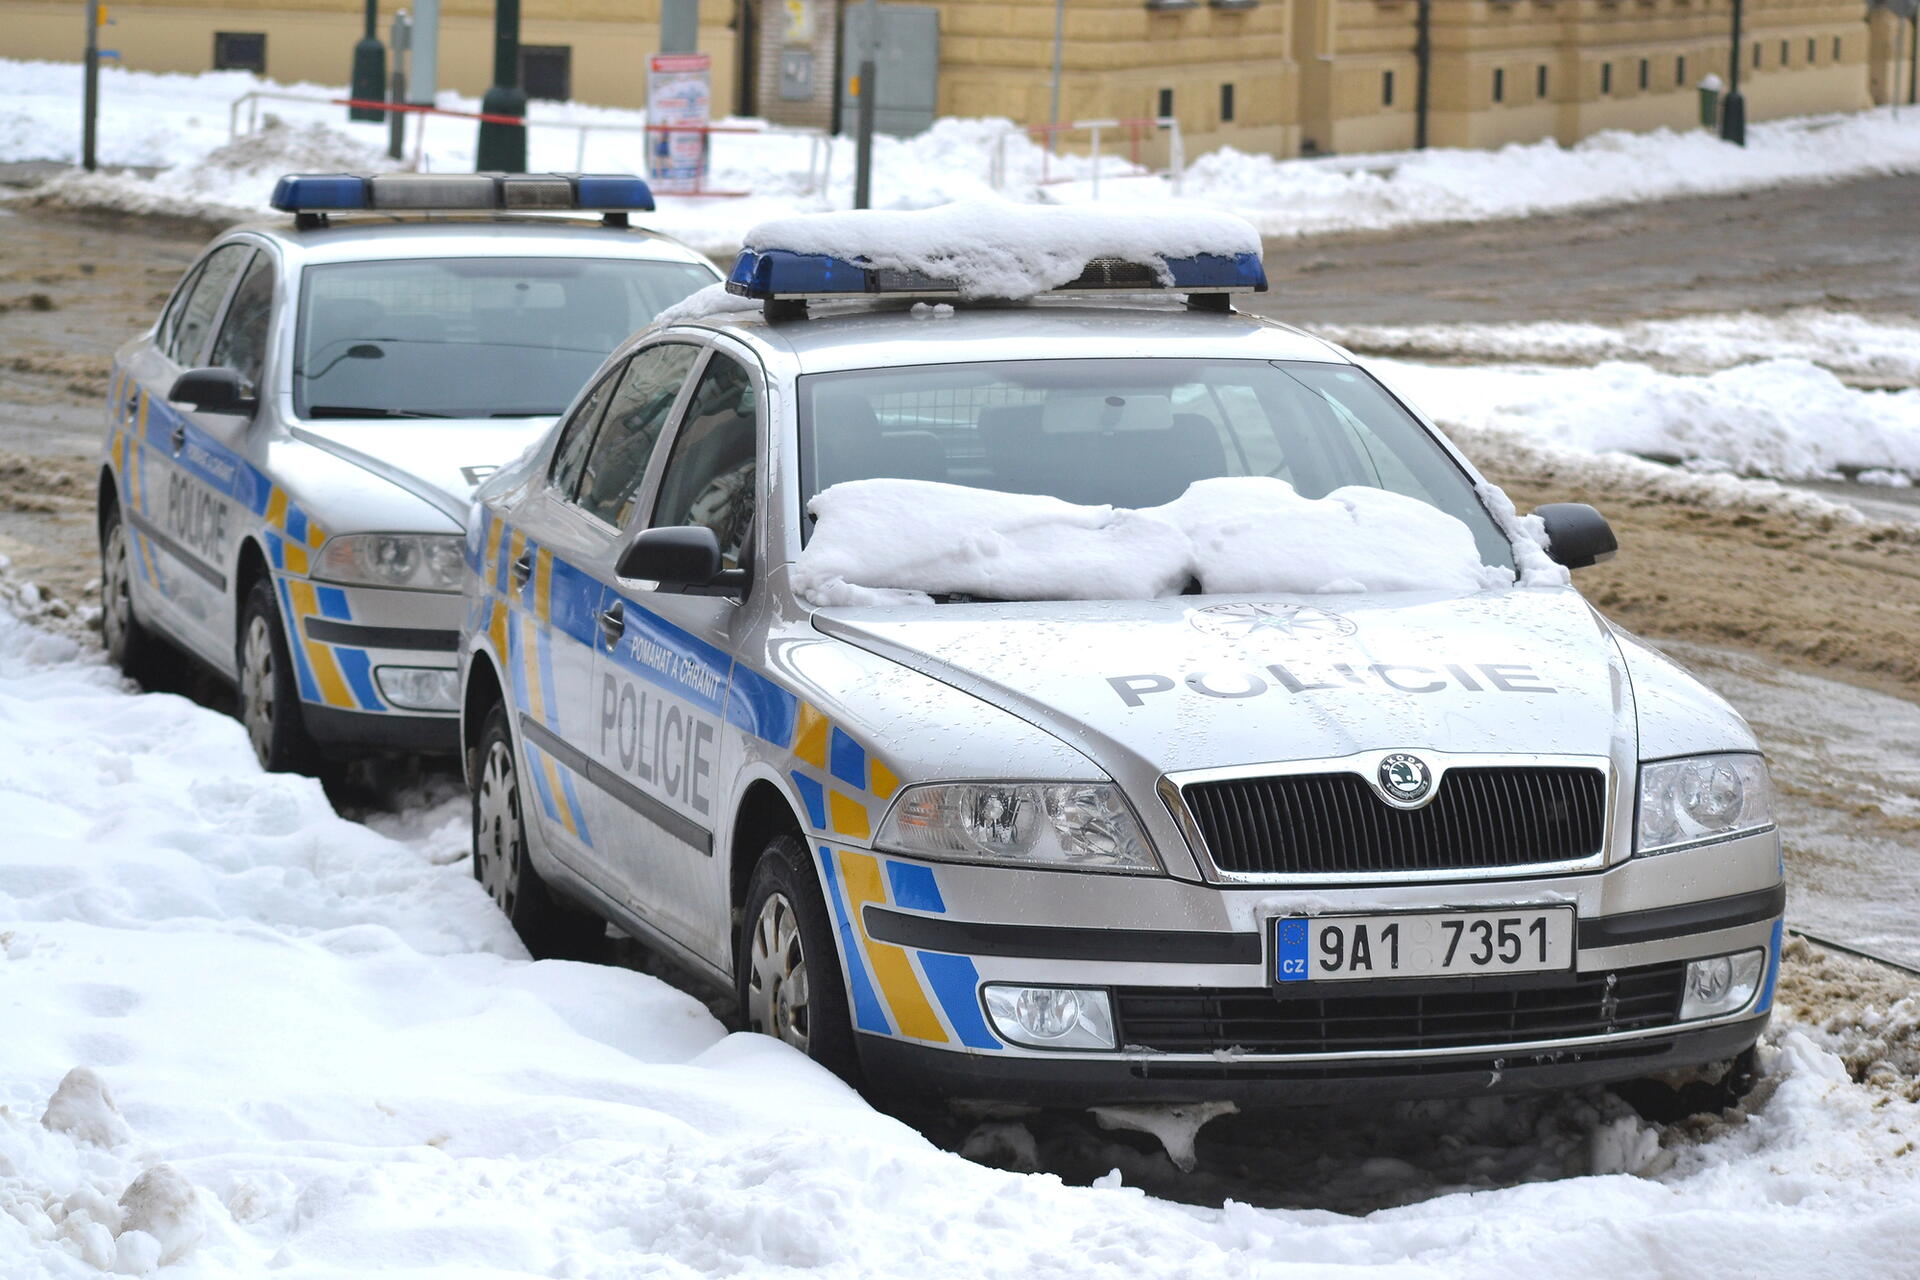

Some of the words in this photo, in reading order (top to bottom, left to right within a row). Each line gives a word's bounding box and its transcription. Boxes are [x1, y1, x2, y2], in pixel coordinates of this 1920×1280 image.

[168, 471, 228, 564] POLICIE
[671, 655, 680, 679] A
[1106, 663, 1557, 707] POLICIE
[602, 672, 714, 817] POLICIE
[1283, 959, 1304, 973] CZ
[1319, 923, 1400, 972] 9A1
[1441, 917, 1547, 968] 7351
